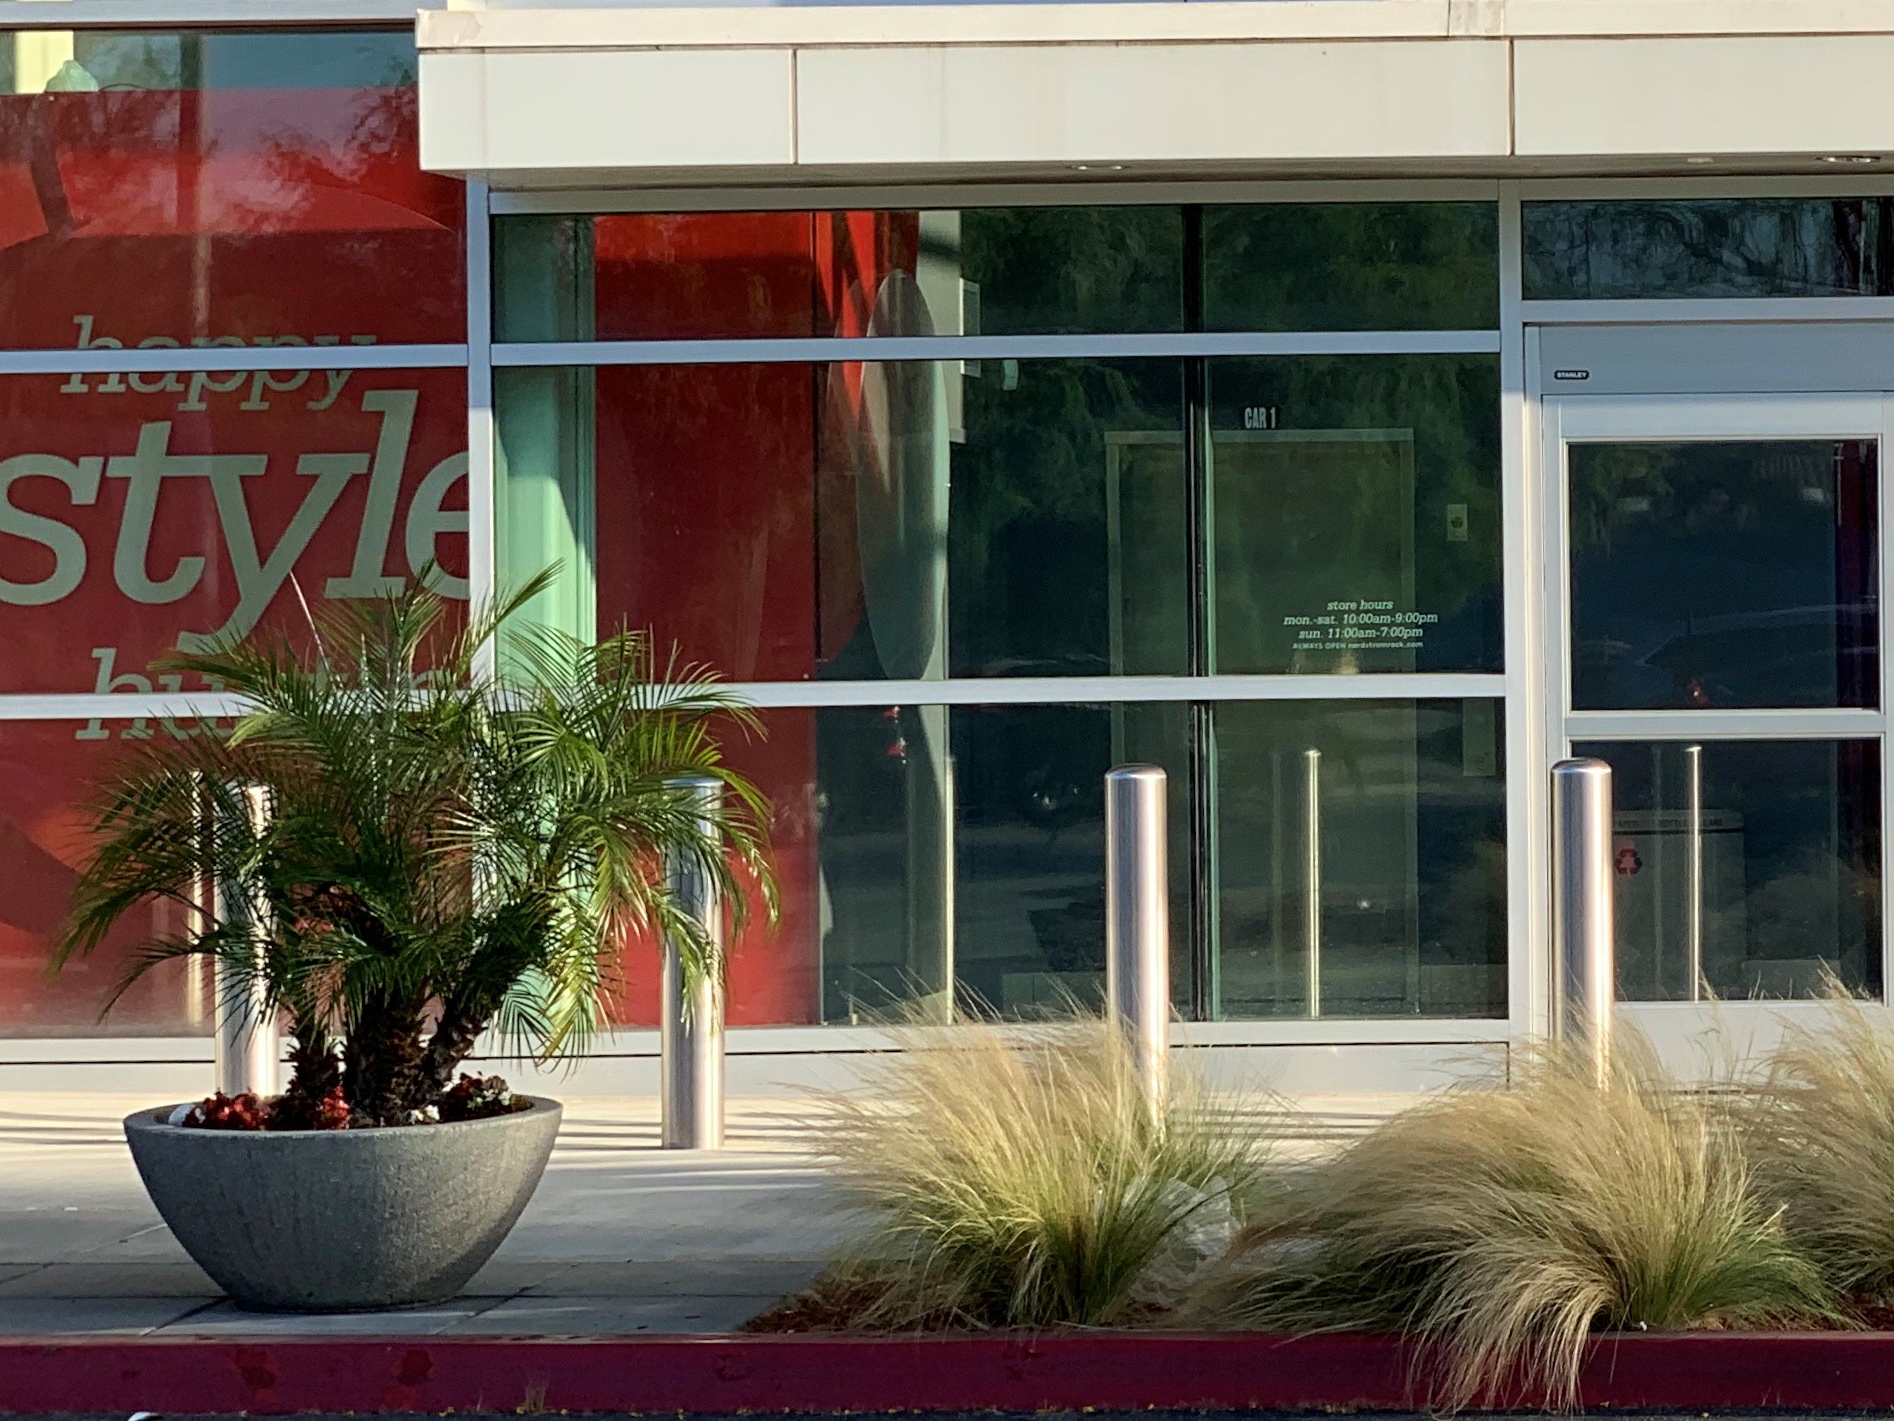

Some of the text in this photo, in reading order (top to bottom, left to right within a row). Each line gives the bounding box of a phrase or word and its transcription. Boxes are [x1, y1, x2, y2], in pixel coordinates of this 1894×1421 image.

[59, 315, 378, 412] happy
[1556, 371, 1587, 379] STANLEY
[1244, 406, 1277, 429] CAR 1
[0, 389, 470, 656] style
[1327, 600, 1394, 611] store hours
[1298, 630, 1323, 639] sun.
